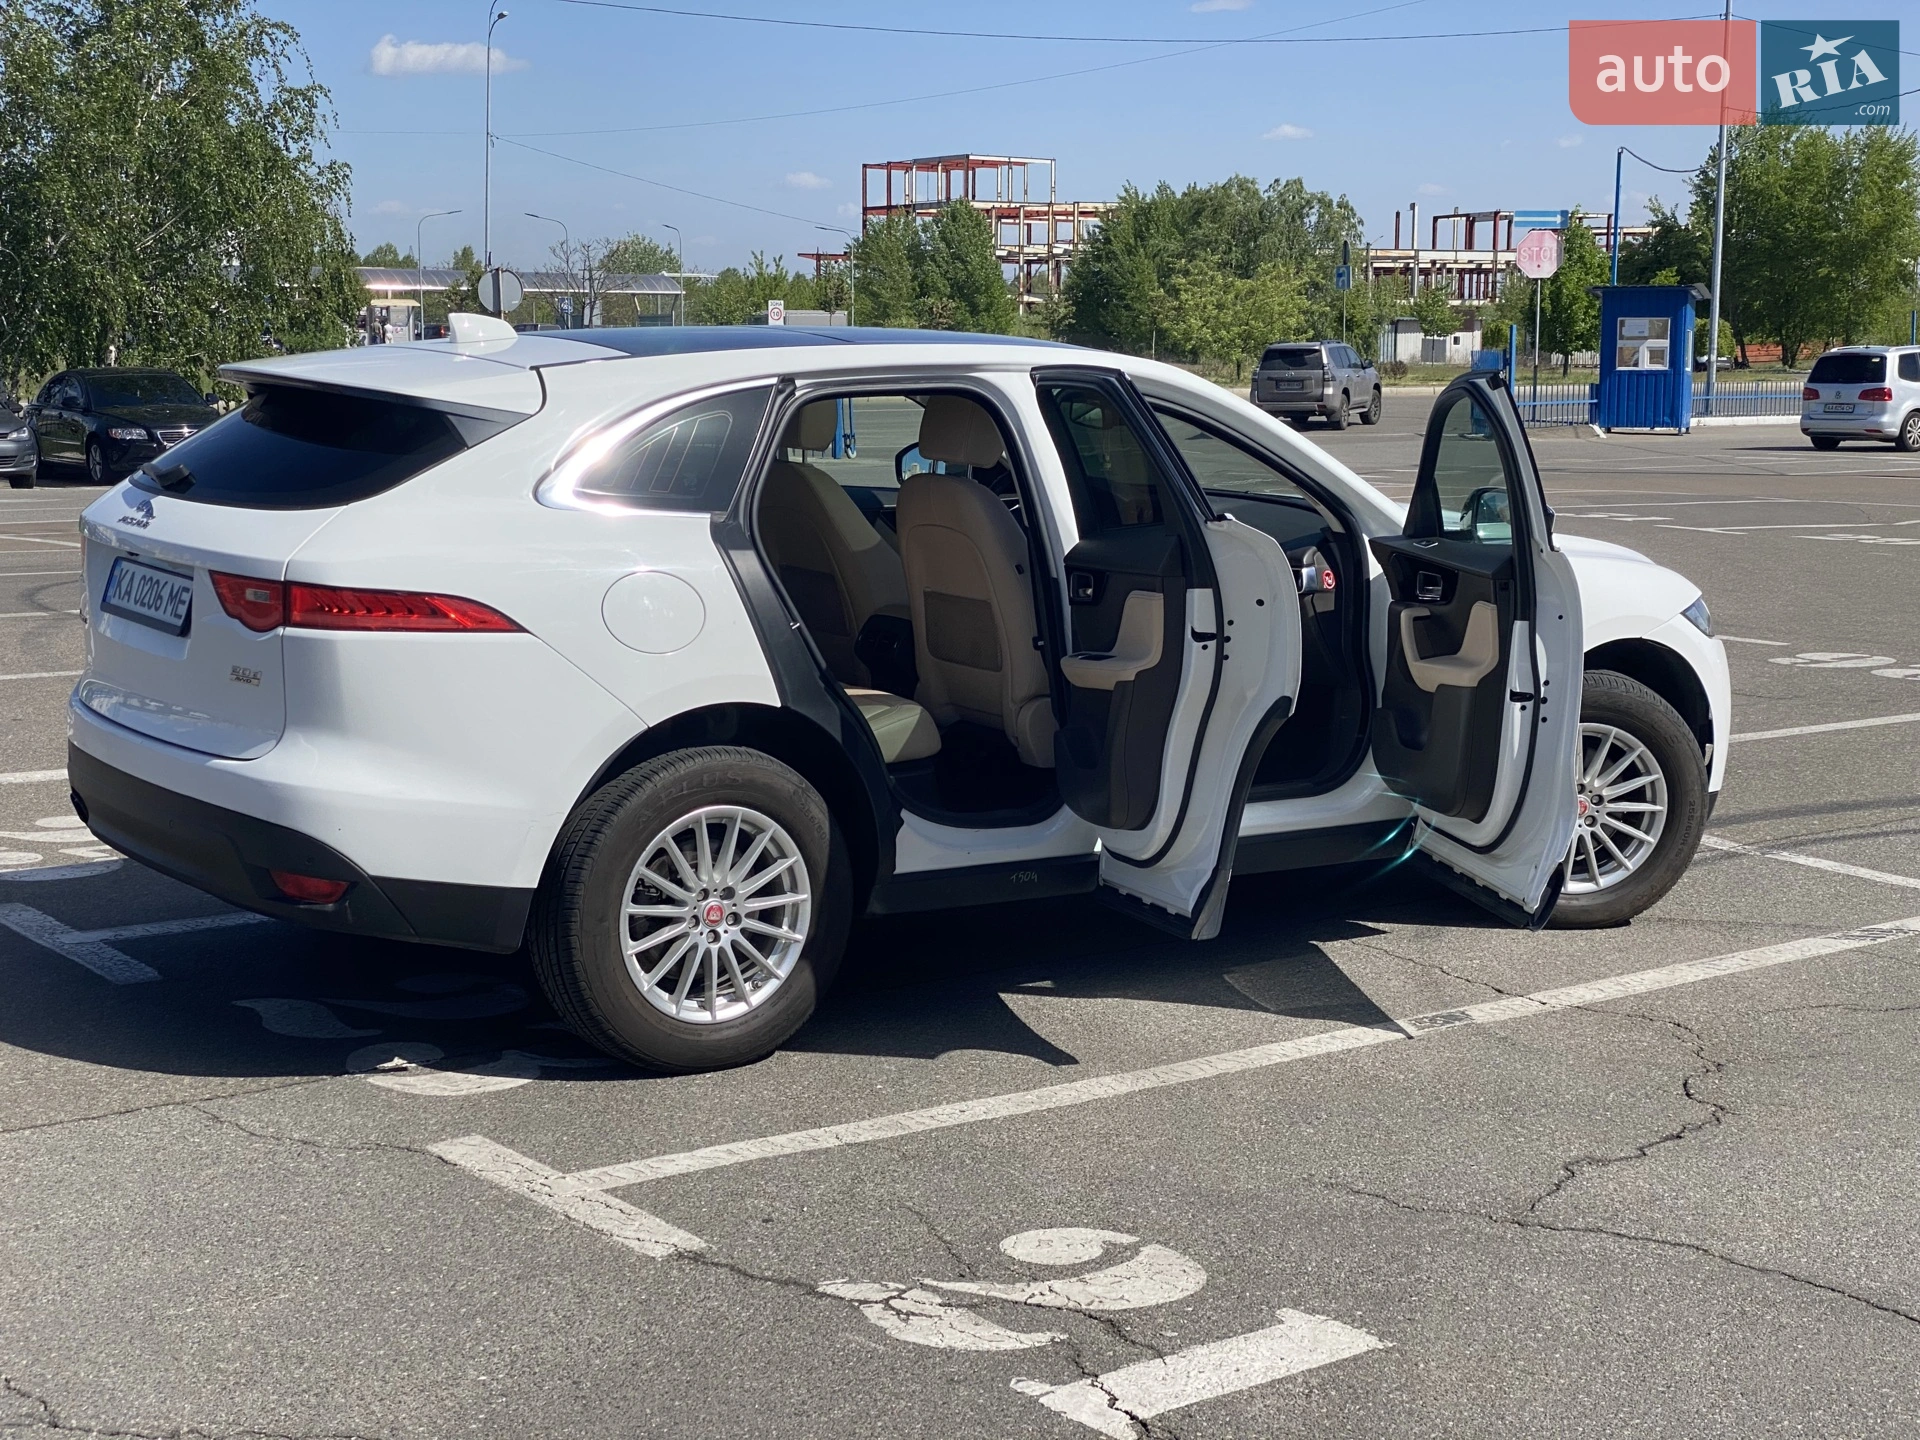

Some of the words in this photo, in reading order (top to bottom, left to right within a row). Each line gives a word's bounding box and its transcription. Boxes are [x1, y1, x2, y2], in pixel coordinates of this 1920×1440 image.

[112, 567, 136, 604] KA
[134, 574, 169, 613] 0206
[163, 582, 191, 620] ME
